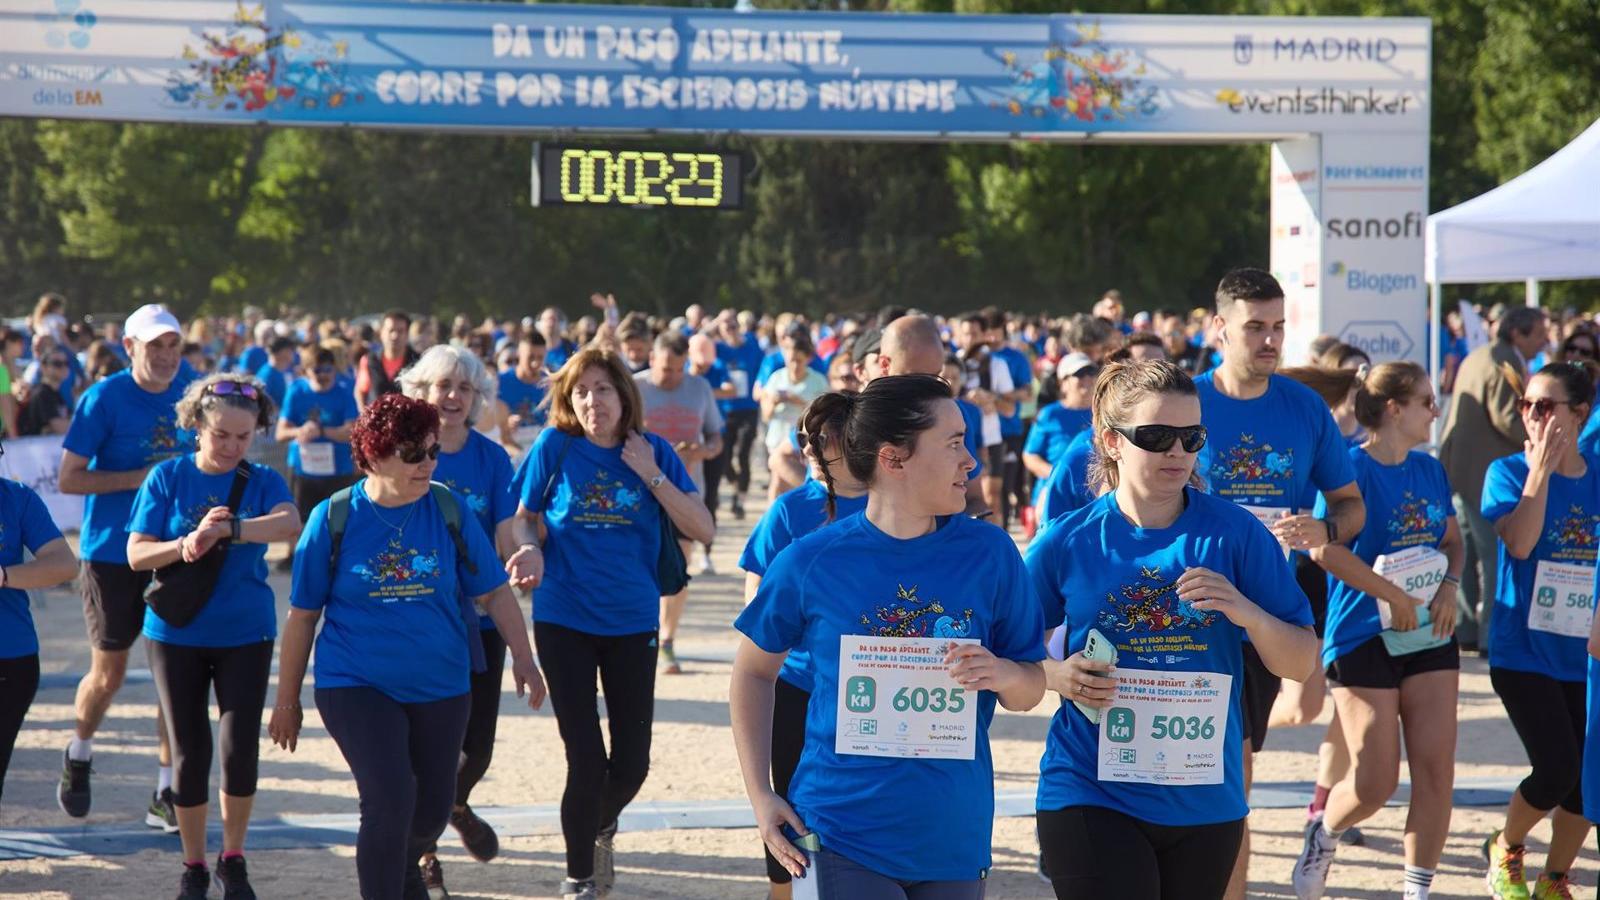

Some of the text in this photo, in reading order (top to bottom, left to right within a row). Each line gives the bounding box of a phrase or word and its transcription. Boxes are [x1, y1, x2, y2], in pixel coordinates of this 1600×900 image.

[491, 23, 849, 66] DA UN PASO ADELANTE,
[1273, 37, 1398, 62] MADRID
[375, 70, 484, 105] CORRE
[495, 72, 563, 107] POR
[622, 74, 809, 110] ESCLEROSIS
[1227, 86, 1412, 117] eventsthinker
[560, 149, 724, 207] 00:02:23
[1326, 212, 1422, 239] sanofi
[1347, 269, 1417, 295] Biogen
[1347, 333, 1401, 354] Roche
[1405, 569, 1443, 592] 5026
[856, 682, 865, 693] 5
[892, 686, 966, 713] 6035
[850, 694, 871, 707] KM
[1117, 713, 1125, 723] 5
[1150, 715, 1216, 740] 5036
[1110, 725, 1130, 737] KM
